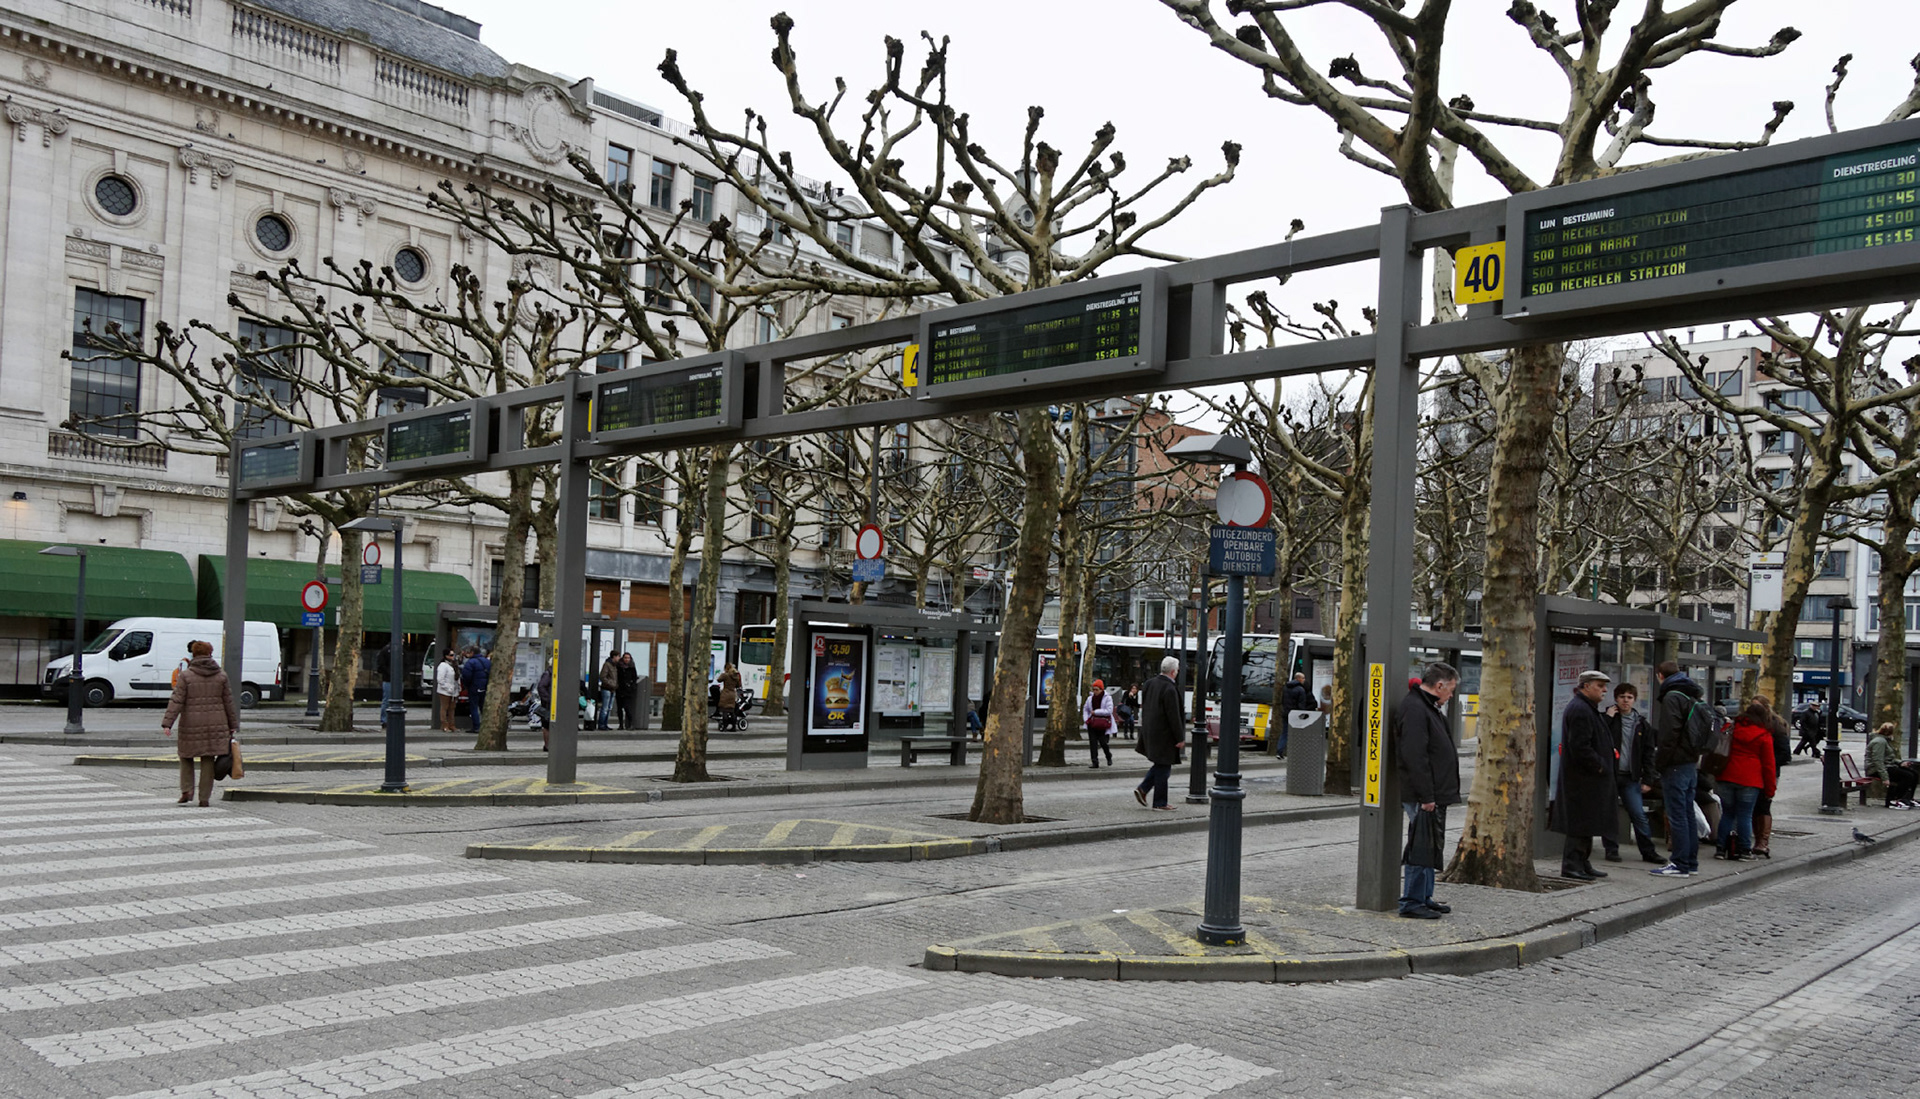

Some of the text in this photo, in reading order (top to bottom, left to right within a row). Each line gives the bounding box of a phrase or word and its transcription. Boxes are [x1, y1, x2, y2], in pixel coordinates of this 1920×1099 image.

[1540, 155, 1916, 230] LIJN BESTEMMING DIENSTREGELING
[1533, 190, 1915, 263] 500 BOOM MARKT 14:45
[1562, 220, 1623, 242] MECHELEN
[1631, 209, 1688, 229] STATION
[1532, 209, 1914, 279] 500 MECHELEN STATION 15:00
[1531, 228, 1914, 296] 500 MECHELEN STATION 15:15
[1464, 254, 1501, 293] 40
[1085, 297, 1126, 311] DIENSTREGELING
[1129, 306, 1140, 317] 14
[1095, 347, 1120, 361] 15:20
[1128, 345, 1139, 356] 59
[202, 486, 228, 499] GUS
[1212, 528, 1273, 542] UITGEZONDERD
[1223, 540, 1265, 552] OPENBARE
[1224, 550, 1262, 562] AUTOBUS
[1222, 561, 1262, 572] DIENSTEN
